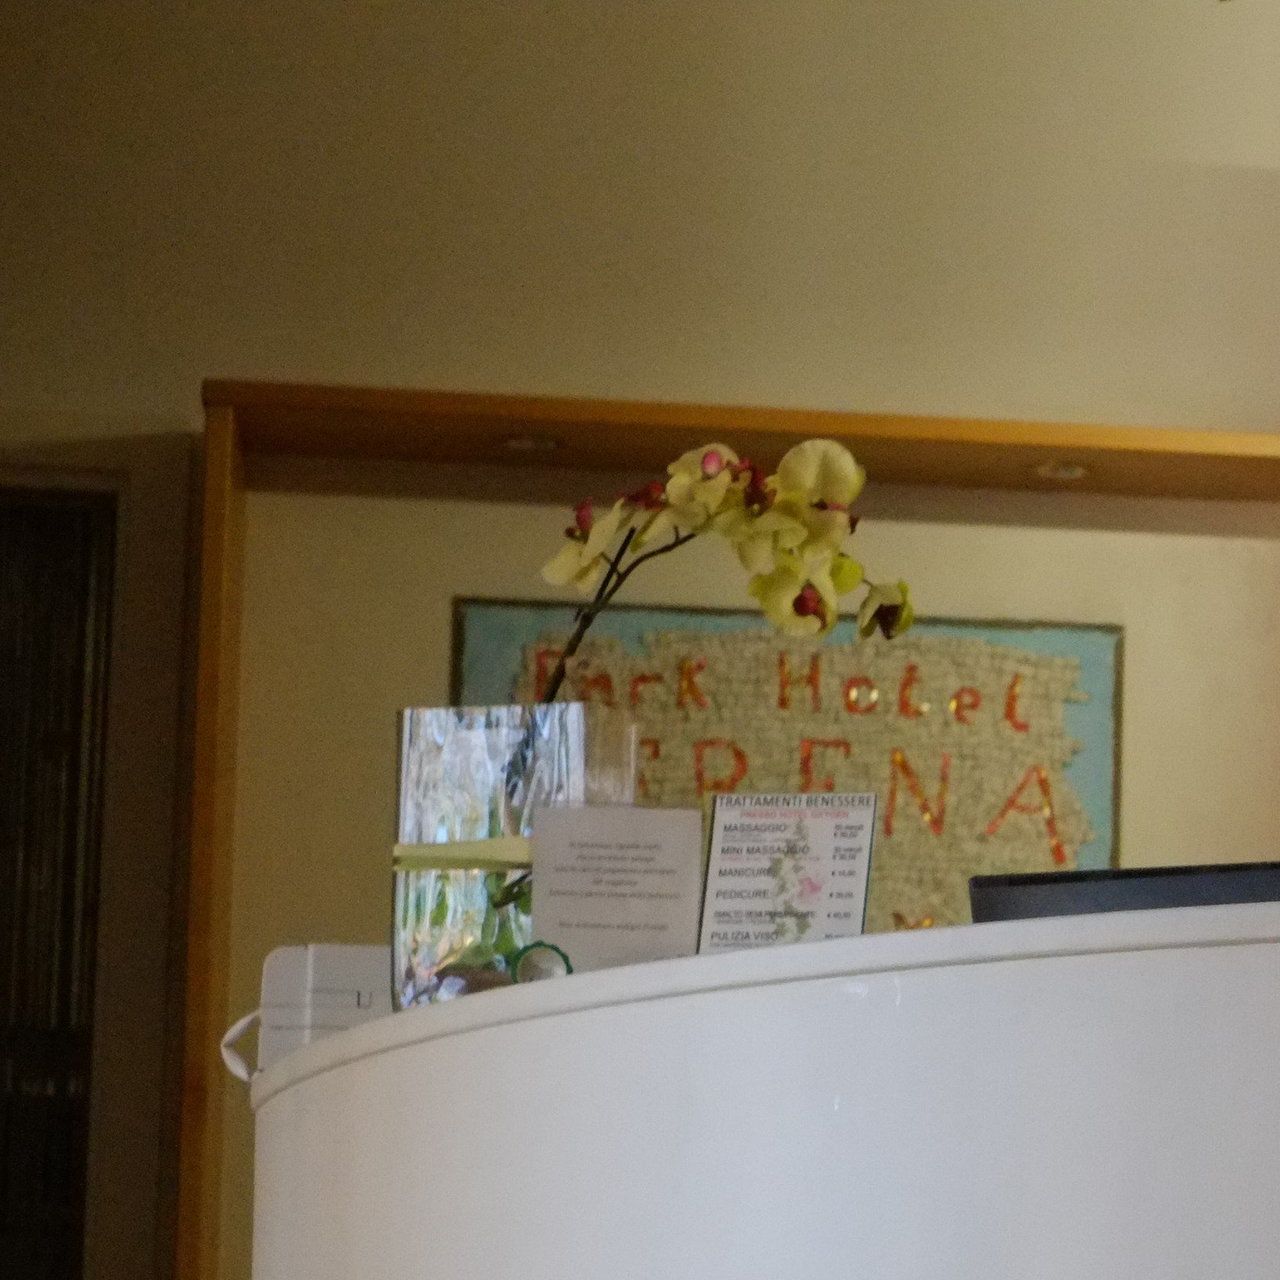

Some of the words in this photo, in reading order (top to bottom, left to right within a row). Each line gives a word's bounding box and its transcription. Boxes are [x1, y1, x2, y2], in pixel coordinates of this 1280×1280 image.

[777, 650, 1031, 732] Hotel
[719, 795, 802, 808] TRATTAMENTI
[805, 795, 872, 807] BENESSERE
[723, 823, 786, 832] MASSAGGIO
[720, 846, 743, 855] MINI
[718, 868, 775, 877] MANICURE
[716, 889, 769, 899] PEDICURE
